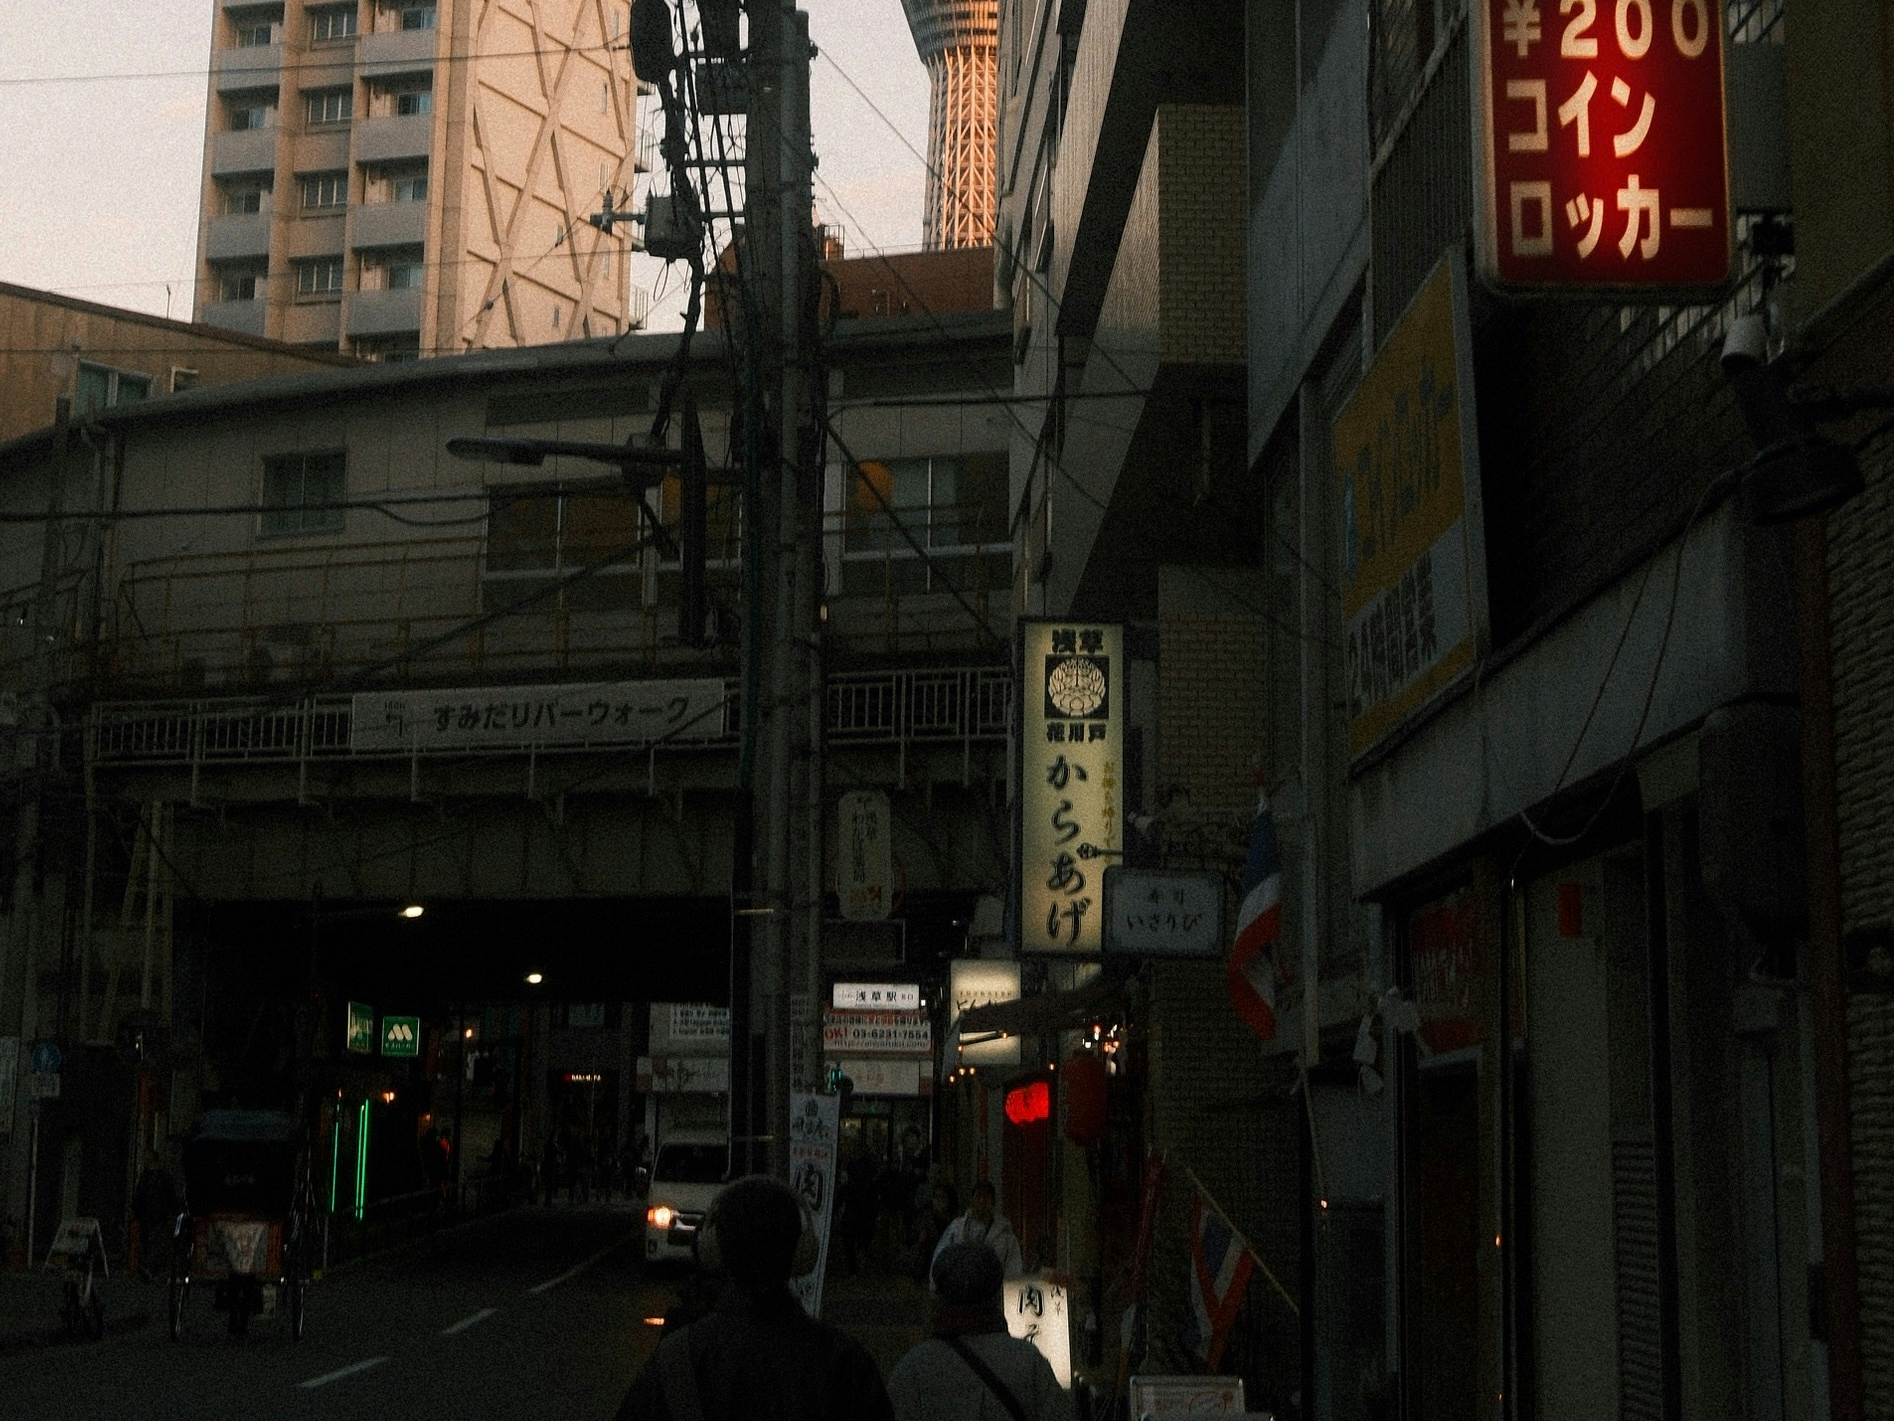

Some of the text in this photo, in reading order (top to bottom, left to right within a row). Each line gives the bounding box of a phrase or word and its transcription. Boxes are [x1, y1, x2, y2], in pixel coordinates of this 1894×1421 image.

[1507, 69, 1656, 159] コイン
[1510, 173, 1714, 261] ロッカー
[1360, 358, 1454, 562] コインロッカー
[1052, 630, 1103, 654] 浅草
[1349, 550, 1437, 716] 24時間営業
[433, 696, 689, 732] すみだリバーウォーク
[1047, 722, 1107, 743] 花川戸
[1047, 754, 1092, 947] からあげ
